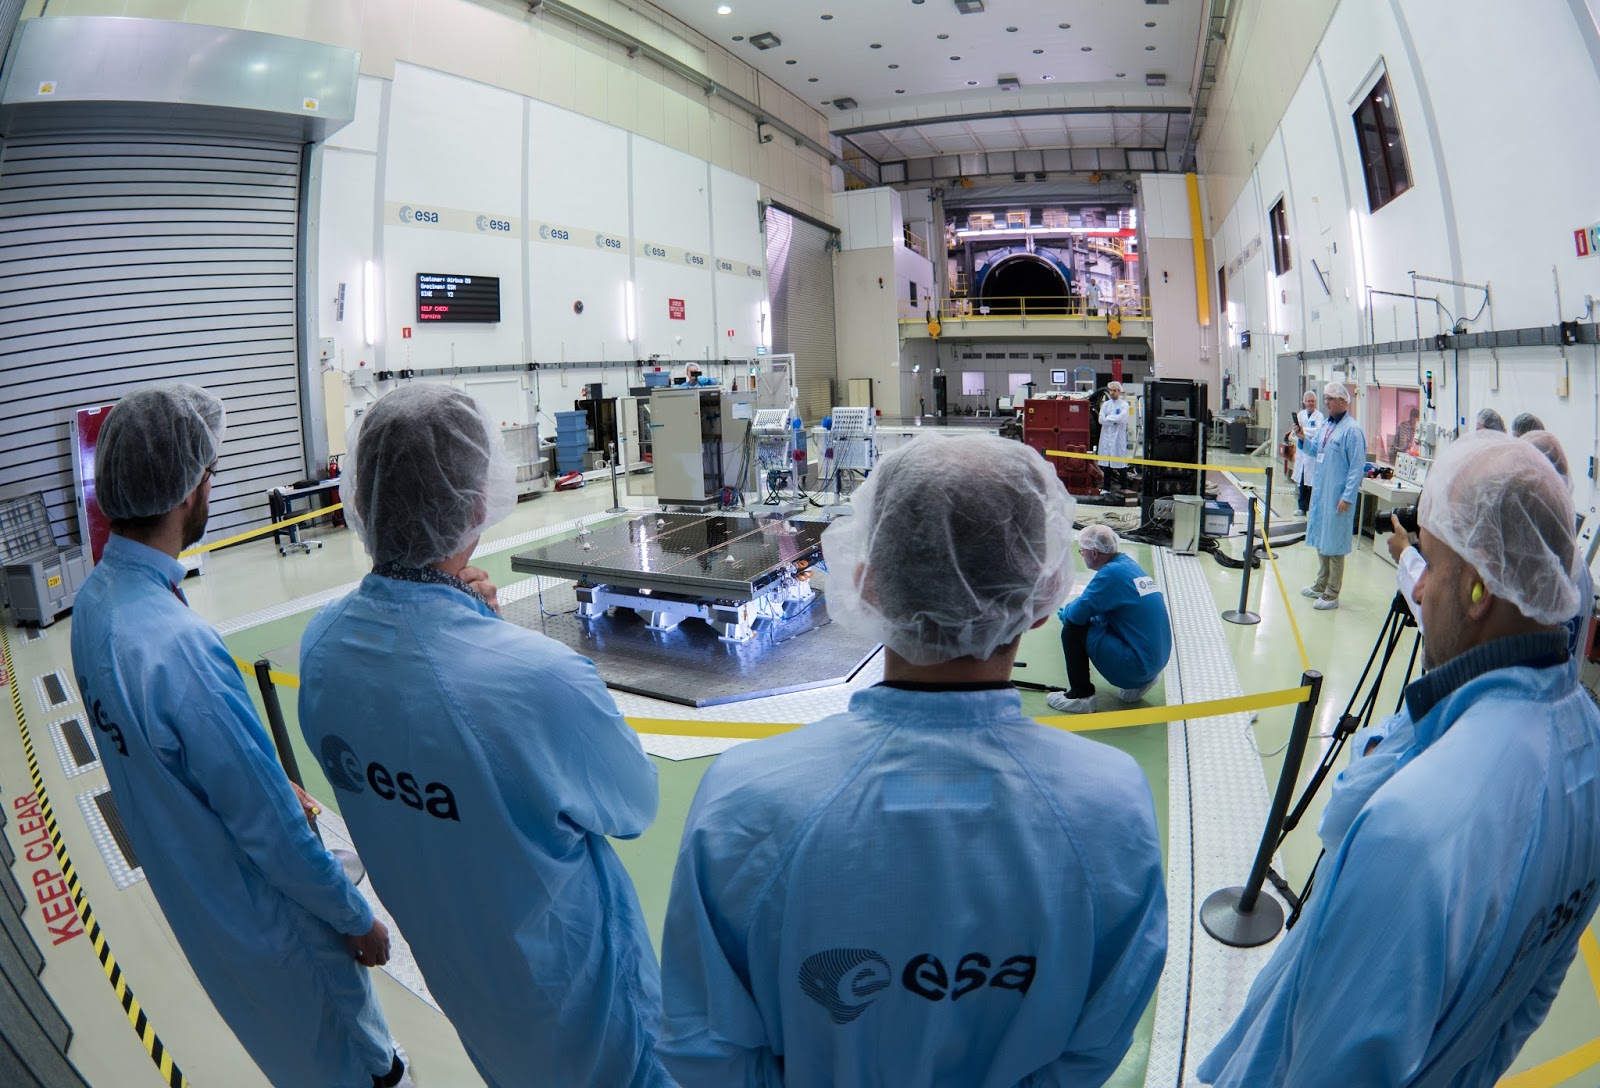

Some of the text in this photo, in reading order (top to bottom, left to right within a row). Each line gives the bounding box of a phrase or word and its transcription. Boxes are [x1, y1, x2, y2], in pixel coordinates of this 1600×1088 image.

[414, 210, 438, 223] esa
[489, 220, 510, 231] esa
[551, 229, 568, 240] esa
[606, 238, 620, 248] esa
[652, 247, 665, 257] esa
[692, 255, 703, 265] esa
[722, 262, 732, 271] esa
[752, 268, 761, 277] esa
[367, 762, 461, 822] esa
[14, 790, 84, 946] KEEP CLEAR
[902, 952, 1037, 1002] esa
